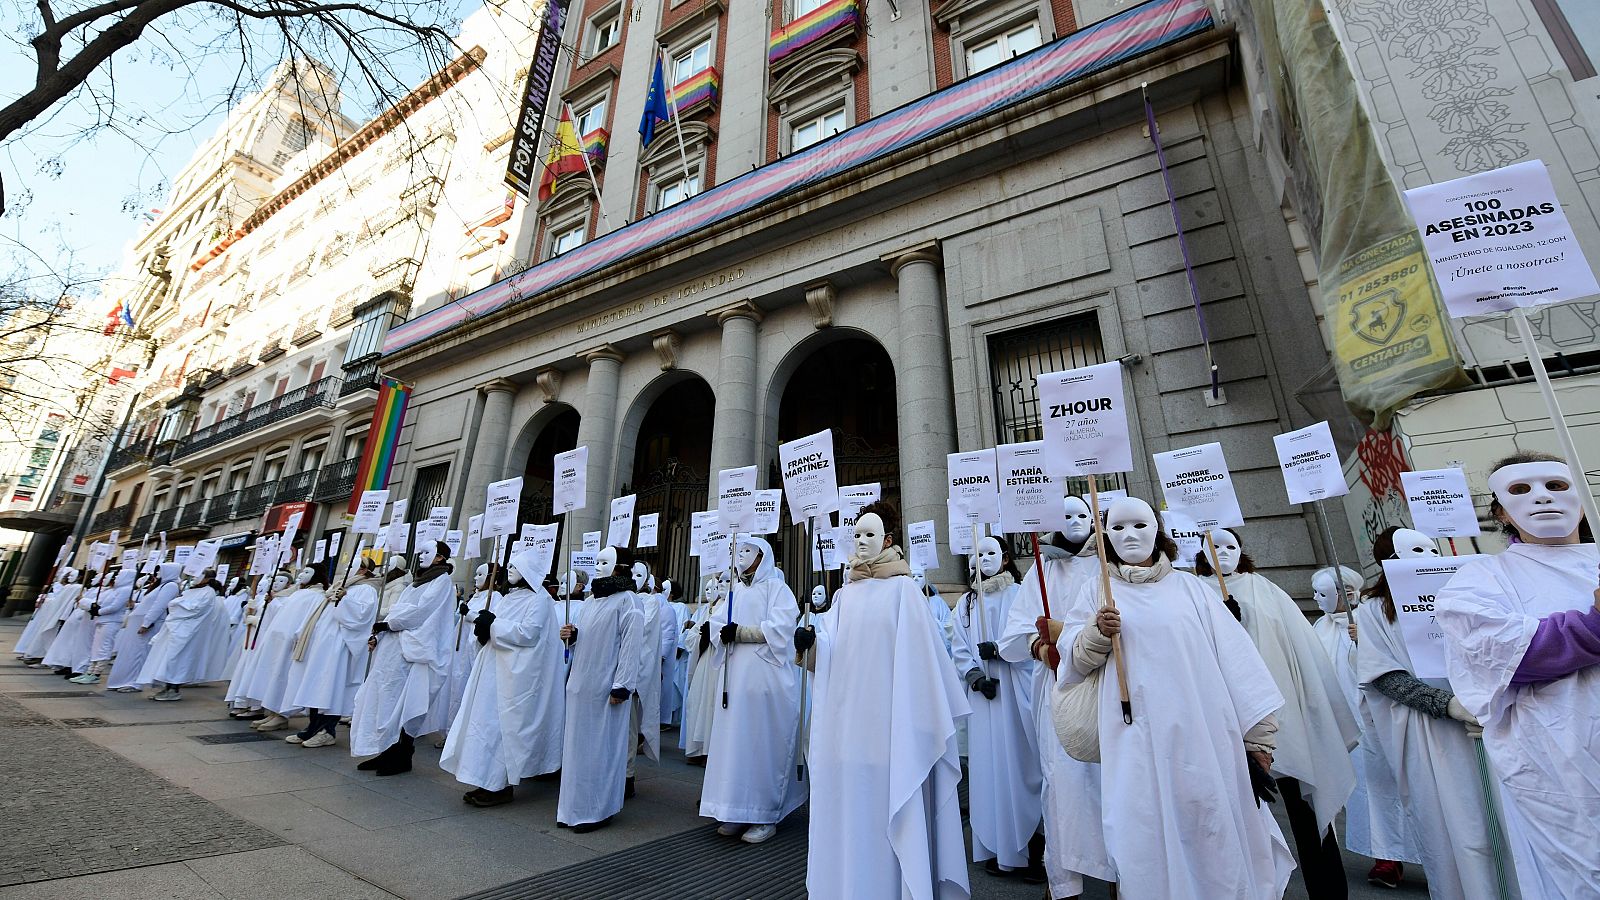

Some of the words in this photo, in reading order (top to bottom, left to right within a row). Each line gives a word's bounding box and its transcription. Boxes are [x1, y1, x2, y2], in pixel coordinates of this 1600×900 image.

[528, 28, 558, 110] MUJERES
[522, 107, 541, 141] SER
[513, 137, 534, 178] POR
[1445, 191, 1490, 203] CONCENTRACIÓN
[1464, 198, 1502, 213] 100
[1425, 202, 1555, 236] ASESINADAS
[1451, 228, 1480, 243] EN
[1481, 221, 1535, 237] 2023
[1354, 234, 1414, 264] CONECTADA
[1434, 249, 1482, 264] MINISTERIO
[1494, 242, 1536, 253] IGUALDAD,
[1536, 235, 1567, 247] 12:00H
[1450, 263, 1493, 281] ¡Únete
[1506, 251, 1565, 270] nosotras!
[1357, 264, 1419, 297] 7853880
[576, 303, 645, 334] MINISTERIO
[652, 294, 669, 308] DE
[677, 268, 745, 300] IGUALDAD
[1353, 338, 1425, 369] CENTAURO
[1049, 397, 1112, 418] ZHOUR
[1065, 420, 1075, 428] 27
[1077, 417, 1098, 427] años
[788, 452, 823, 470] FRANCY
[1284, 452, 1331, 469] DESCONOCIDO
[1292, 450, 1320, 461] NOMBRE
[784, 459, 830, 480] MARTÍNEZ
[1012, 466, 1043, 477] MARÍA
[1176, 469, 1210, 480] NOMBRE
[802, 474, 818, 482] años
[952, 475, 991, 487] SANDRA
[1006, 476, 1042, 486] ESTHER
[1042, 476, 1053, 484] R.
[1166, 473, 1224, 489] DESCONOCIDO
[720, 491, 752, 499] DESCONOCIDO
[1183, 487, 1192, 495] 33
[1194, 485, 1213, 493] años
[1410, 493, 1464, 502] ENCARNACIÓN
[708, 534, 727, 542] CARMEN
[1418, 594, 1436, 603] NO
[1402, 604, 1435, 613] DESC
